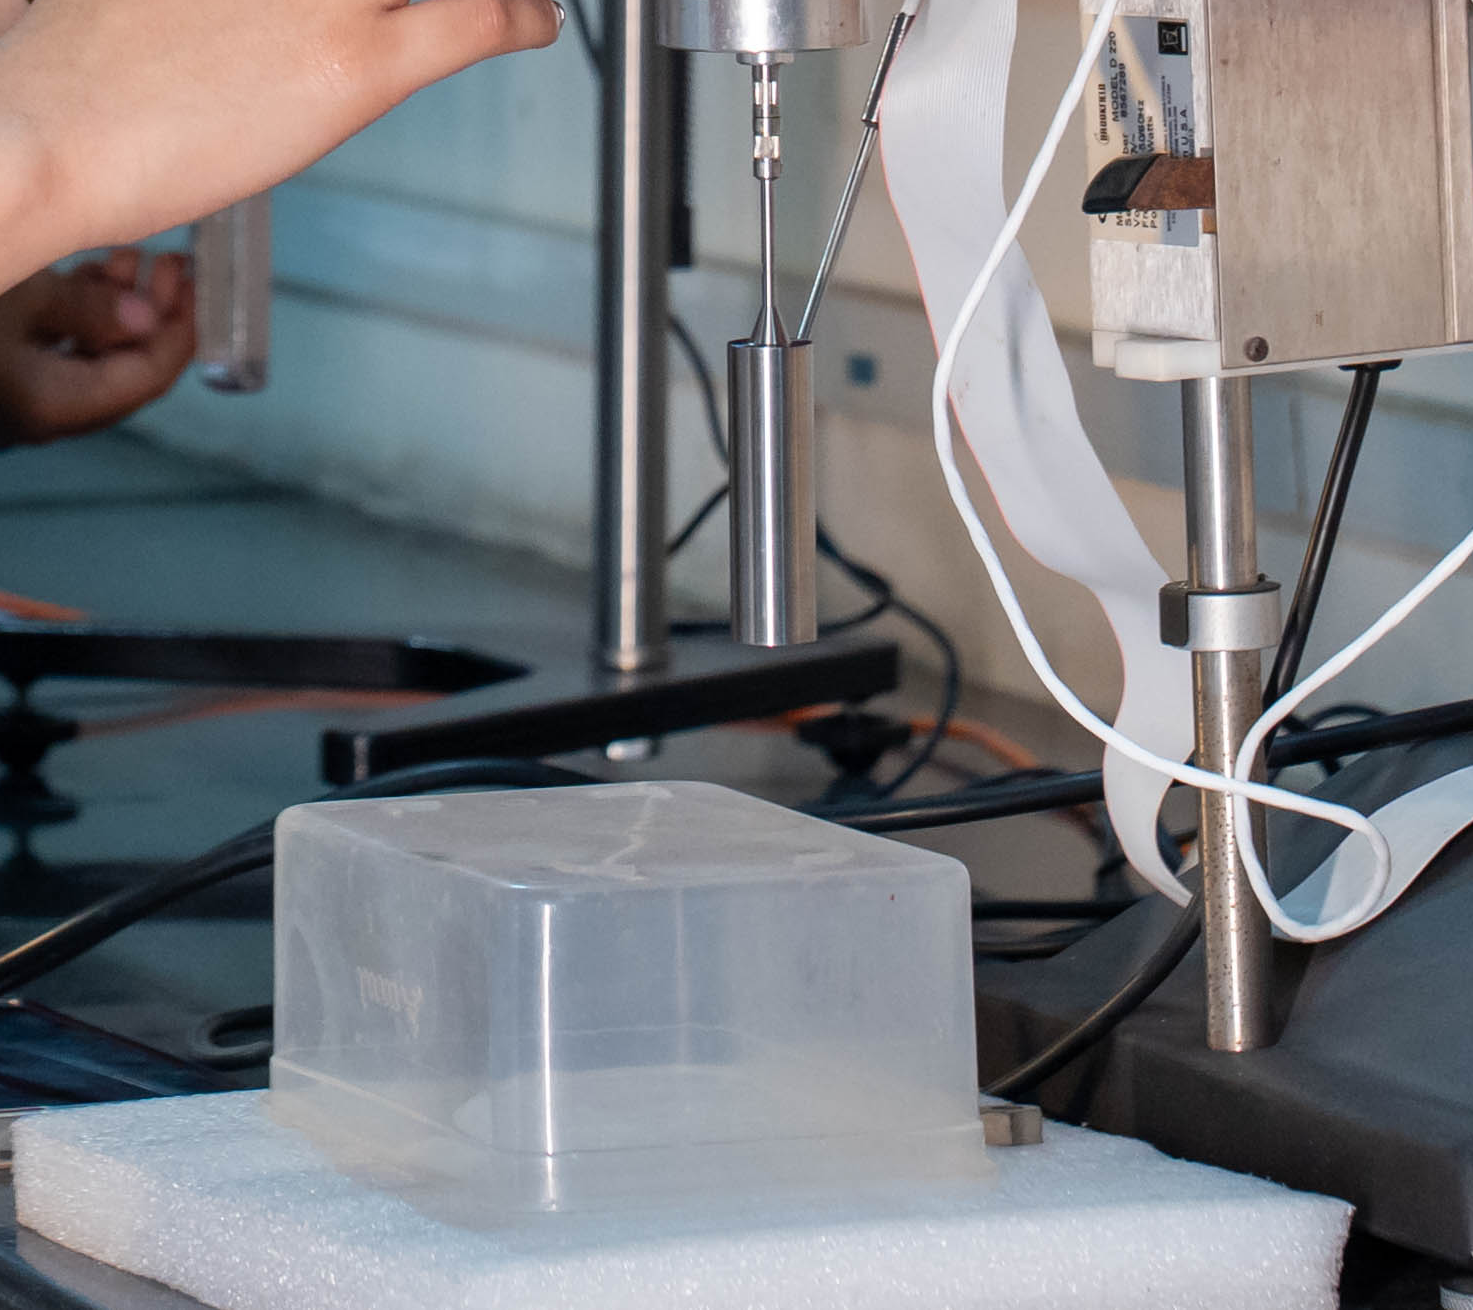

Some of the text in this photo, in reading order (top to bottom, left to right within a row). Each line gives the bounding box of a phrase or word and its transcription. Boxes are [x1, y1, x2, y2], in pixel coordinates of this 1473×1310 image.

[1108, 31, 1120, 122] MODEL D 220
